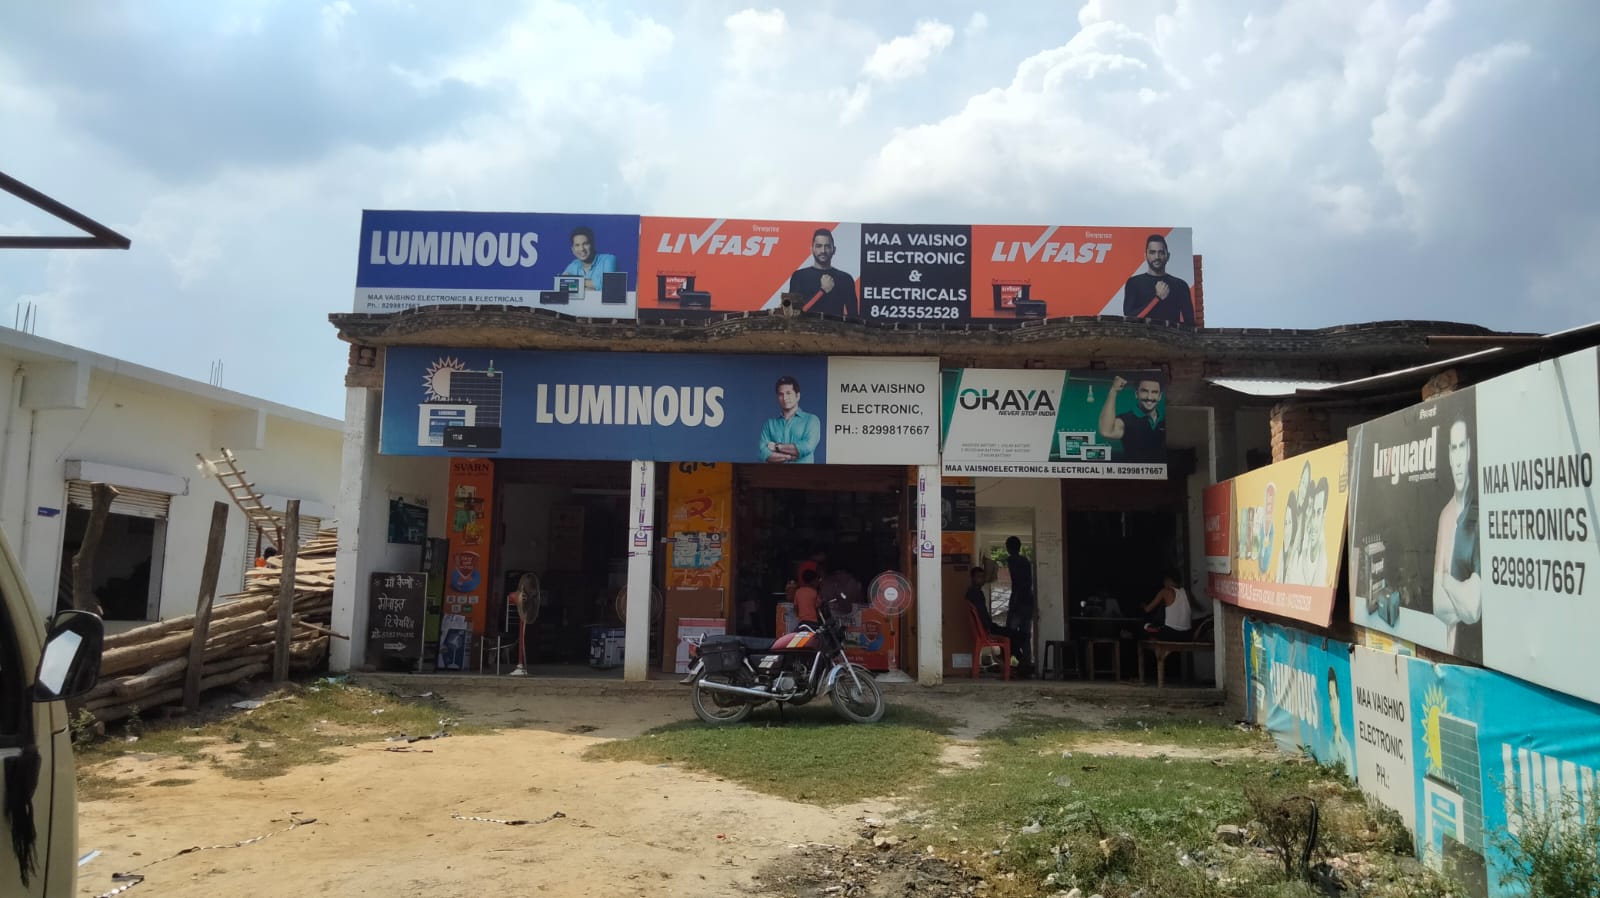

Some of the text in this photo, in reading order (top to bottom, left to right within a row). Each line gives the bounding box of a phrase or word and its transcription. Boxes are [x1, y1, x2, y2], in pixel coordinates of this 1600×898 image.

[656, 218, 780, 256] LIVFAST
[864, 232, 968, 247] MAA VAISNO
[991, 225, 1113, 263] LIVFAST
[370, 230, 539, 268] LUMINOUS
[866, 251, 966, 266] ELECTRONIC
[908, 269, 923, 283] &
[385, 294, 416, 302] VAISHNO
[863, 287, 968, 302] ELECTRICALS
[870, 305, 960, 320] 8423552528
[840, 382, 926, 395] MAA VAISHNO
[536, 383, 724, 428] LUMINOUS
[960, 388, 1055, 411] OKAYA
[841, 403, 924, 417] ELECTRONIC,
[834, 424, 930, 436] PH.: 8299817667
[1373, 427, 1438, 484] Livguard
[454, 463, 490, 472] SVARN
[945, 464, 963, 473] MAA
[1051, 466, 1101, 475] ELECTRICAL
[1106, 466, 1116, 475] M.
[1117, 467, 1163, 475] 8299817667
[1483, 452, 1593, 495] MAA VAISHANO
[1488, 507, 1588, 542] ELECTRONICS
[1492, 556, 1586, 596] 8299817667
[1356, 686, 1405, 723] MAA VAISHNO
[1359, 720, 1407, 764] ELECTRONIC,
